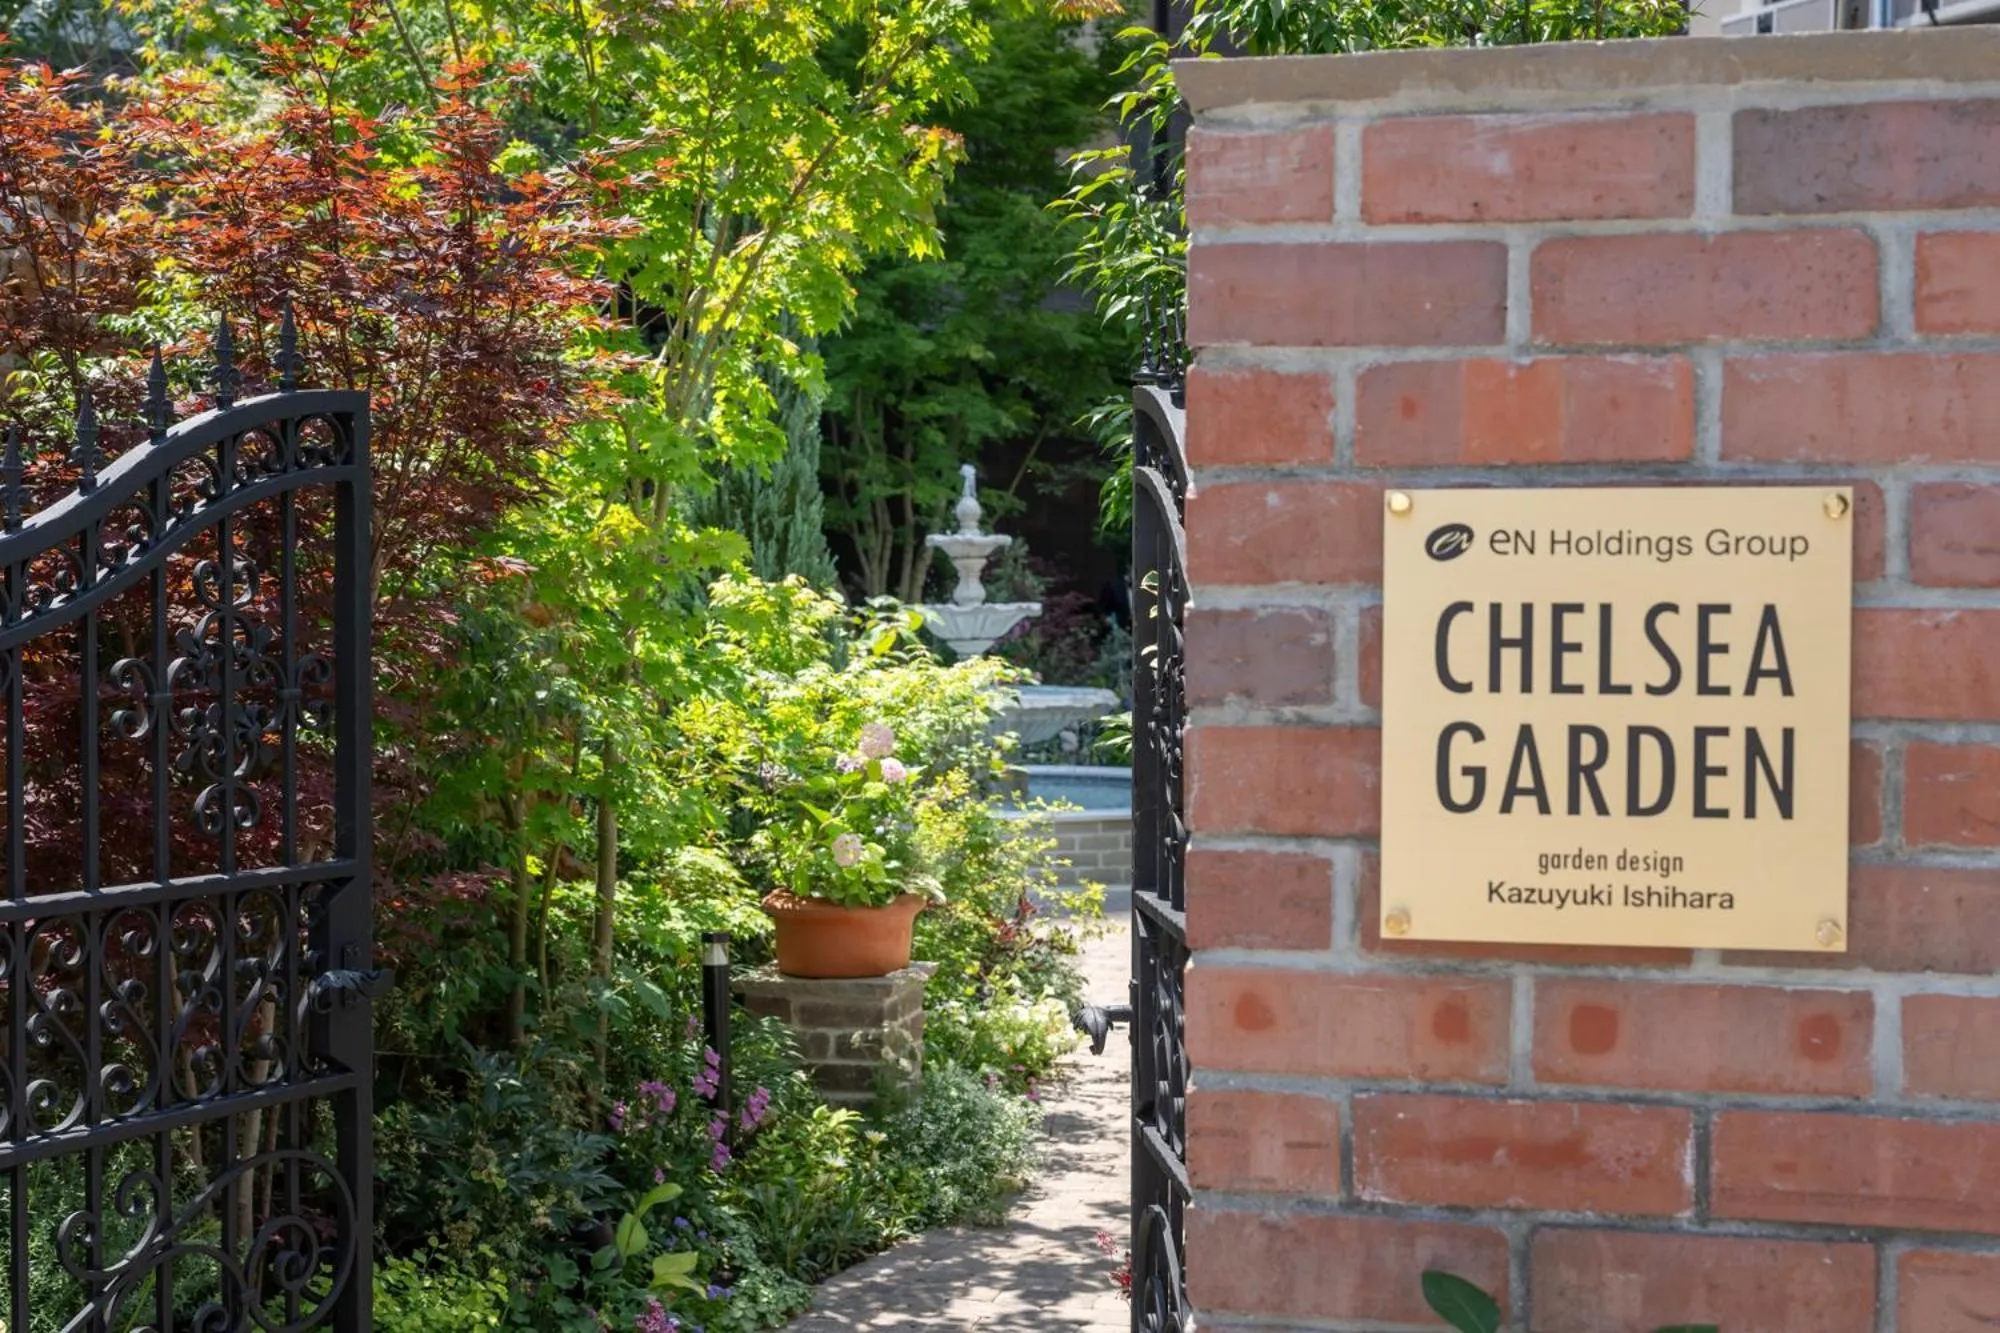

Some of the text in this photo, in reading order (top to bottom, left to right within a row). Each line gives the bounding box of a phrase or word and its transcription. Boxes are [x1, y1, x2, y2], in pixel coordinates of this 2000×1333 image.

[1489, 529, 1535, 556] eN
[1549, 529, 1693, 563] Holdings
[1705, 528, 1809, 562] Group
[1434, 600, 1795, 697] CHELSEA
[1435, 721, 1795, 821] GARDEN
[1537, 847, 1684, 878] garden design
[1488, 881, 1735, 910] Kazuyuki Ishihara
